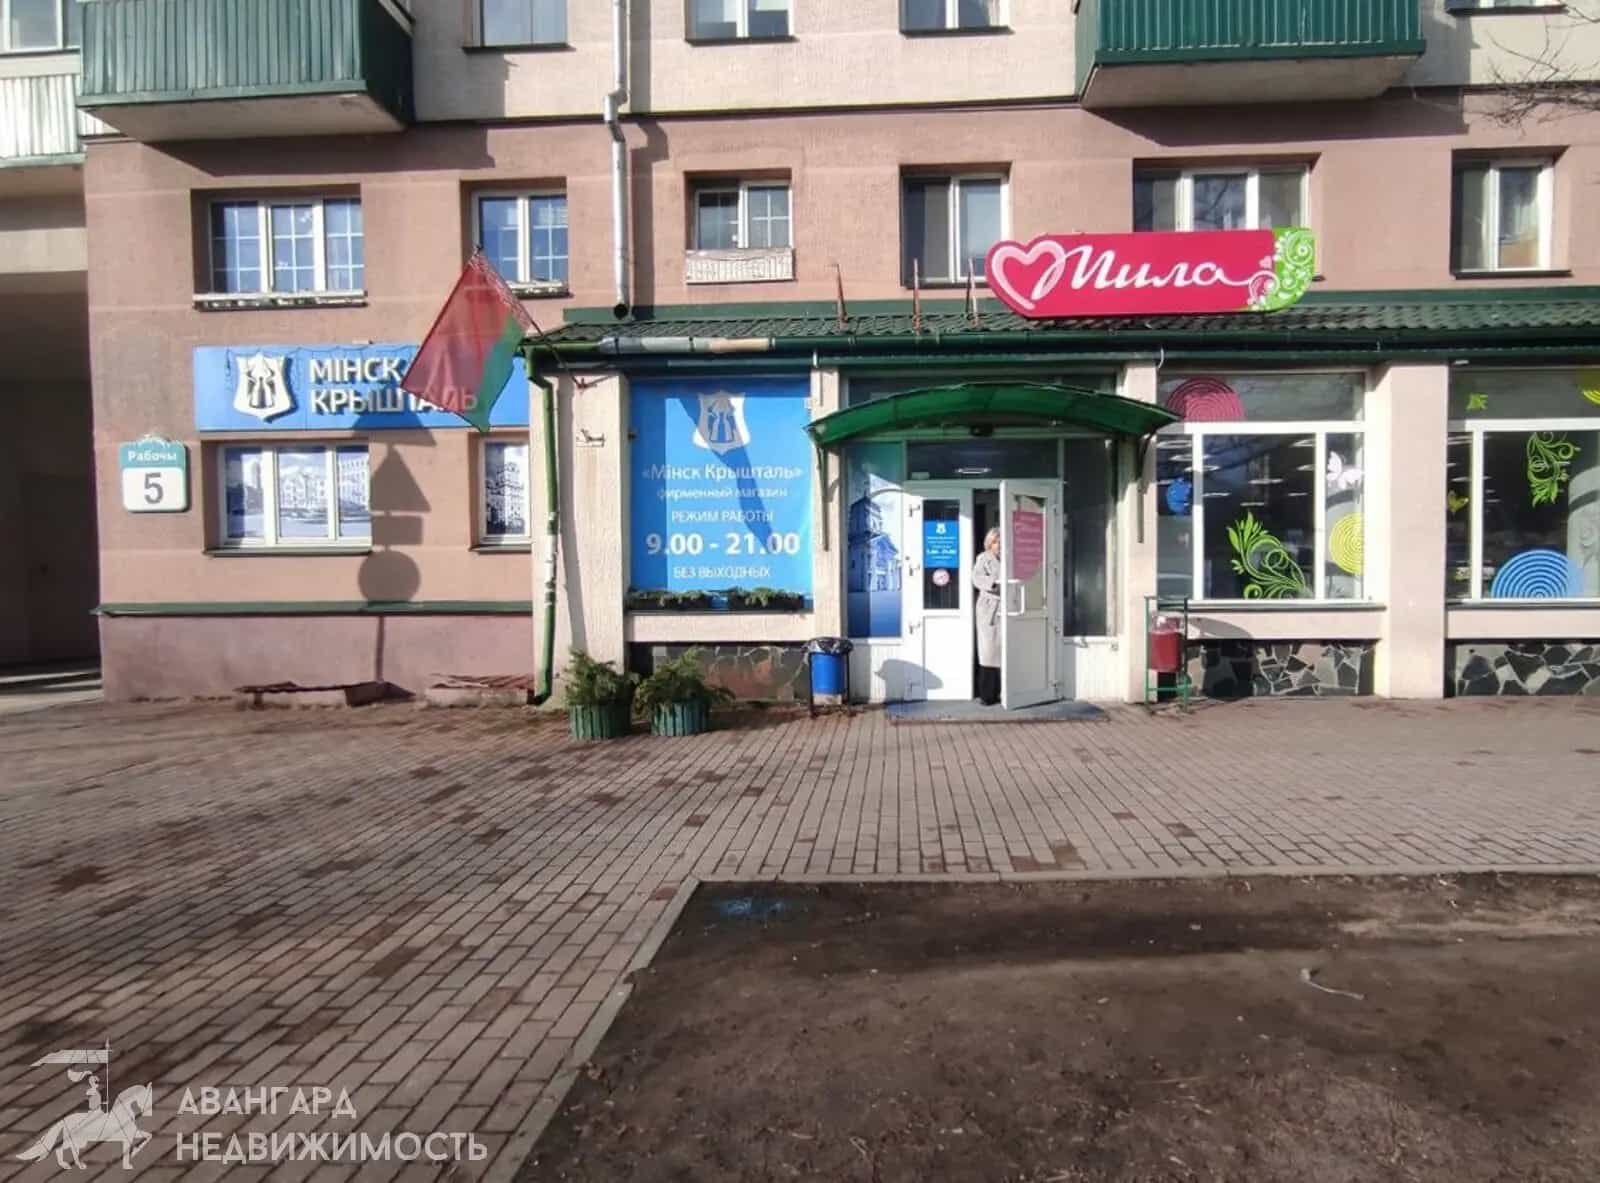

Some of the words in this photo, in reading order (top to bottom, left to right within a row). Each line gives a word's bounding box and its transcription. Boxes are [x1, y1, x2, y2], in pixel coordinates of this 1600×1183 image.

[1031, 245, 1250, 300] Мила
[309, 357, 402, 383] МІНСК
[144, 472, 163, 504] 5
[672, 511, 719, 522] РЕЖИМ
[721, 511, 774, 522] РАБОТЫ
[646, 533, 704, 555] 9.00
[725, 533, 801, 555] 21.00
[674, 567, 696, 579] БЕЗ
[698, 567, 770, 579] ВЫХОДНЫХ
